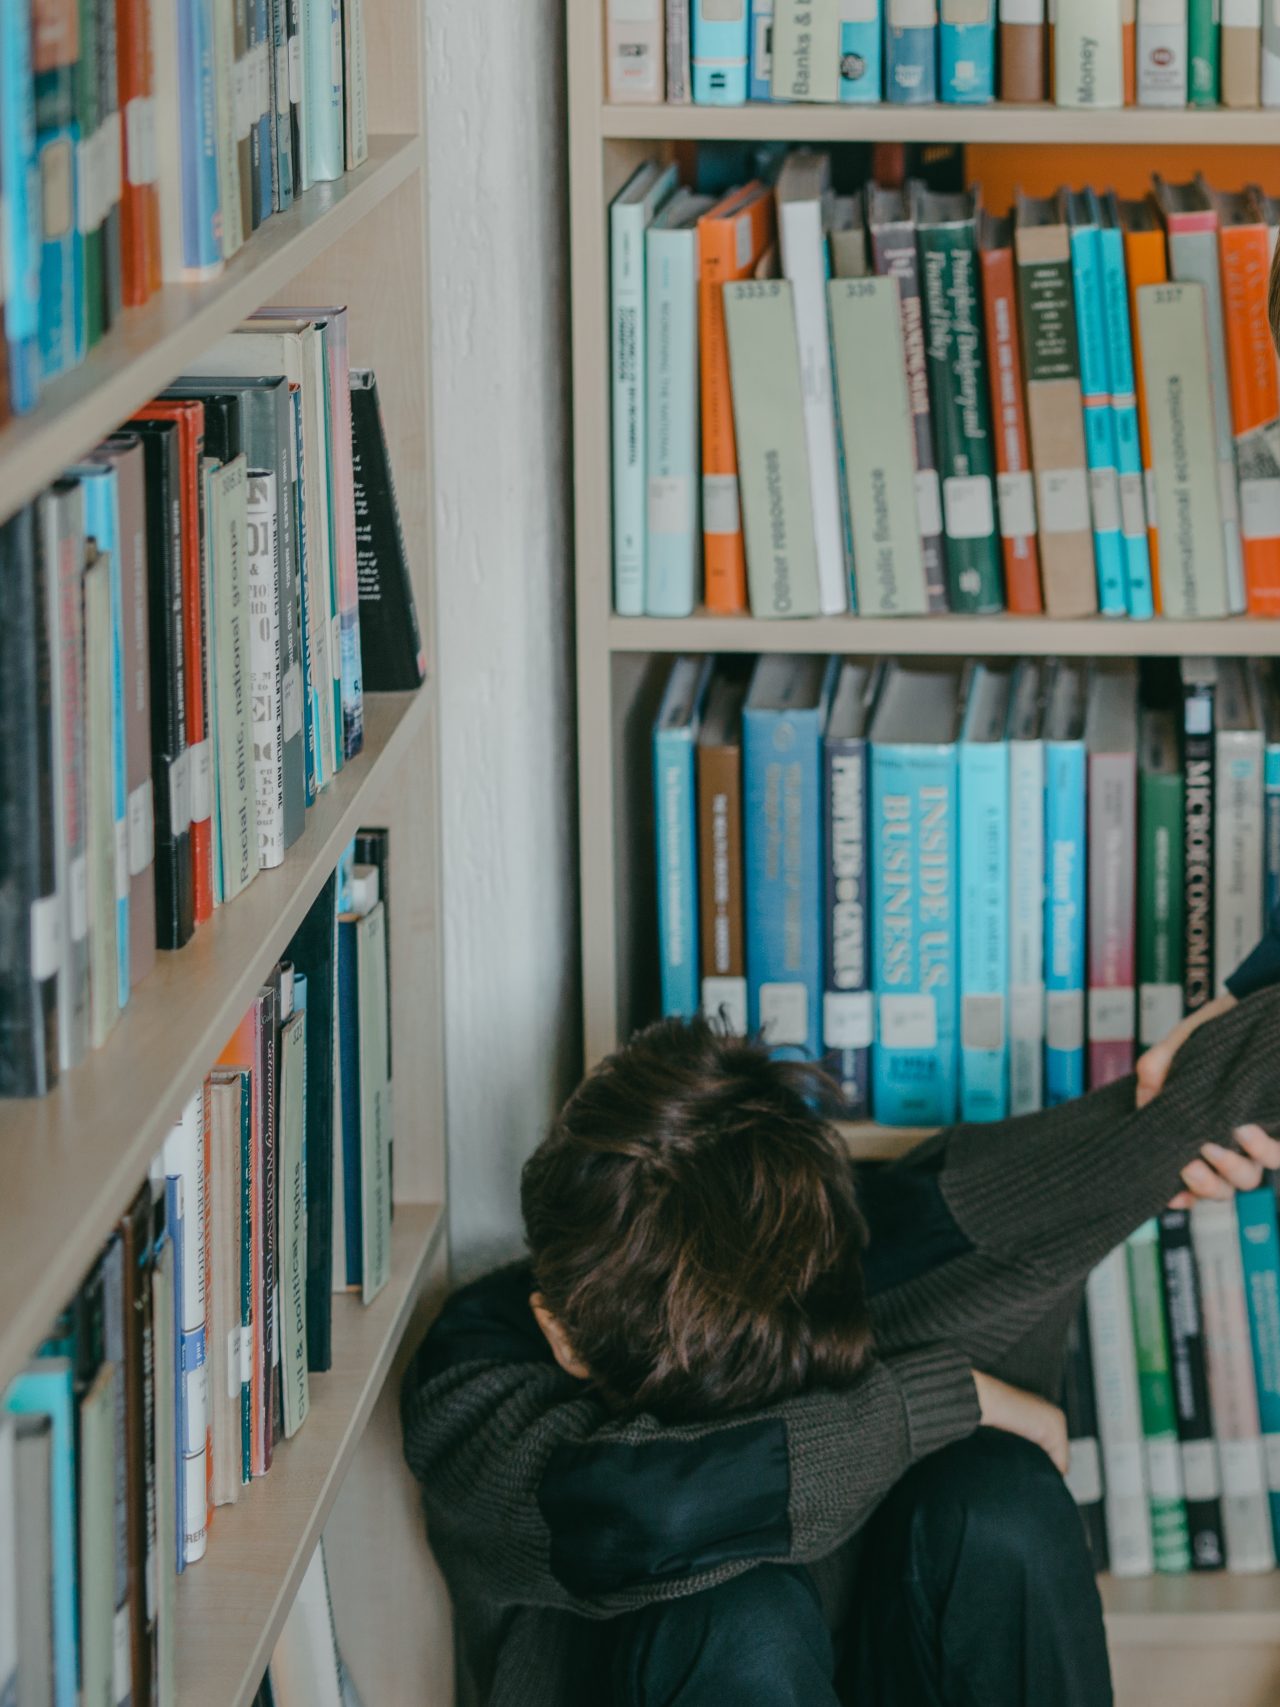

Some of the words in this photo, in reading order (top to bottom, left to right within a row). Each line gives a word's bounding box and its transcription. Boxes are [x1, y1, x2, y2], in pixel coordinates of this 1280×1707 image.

[795, 12, 811, 26] &
[792, 34, 810, 95] Banks
[1077, 36, 1098, 102] Money
[925, 251, 950, 317] Financial
[1166, 368, 1192, 482] economics
[763, 450, 786, 550] resources
[869, 468, 891, 543] finance
[229, 518, 241, 607] groups
[772, 555, 792, 613] Other
[875, 547, 898, 610] Public
[230, 615, 243, 716] national
[232, 720, 247, 791] ethic,
[234, 795, 250, 883] Racial,
[918, 785, 949, 922] INSIDE
[881, 794, 912, 985] BUSINESS
[1185, 761, 1212, 1007] MICROECONOMICS
[918, 930, 949, 995] U.S.
[265, 1039, 274, 1149] Extraordinary
[293, 1162, 303, 1232] rights
[291, 1239, 305, 1335] political
[295, 1342, 304, 1360] &
[295, 1366, 306, 1421] Civil
